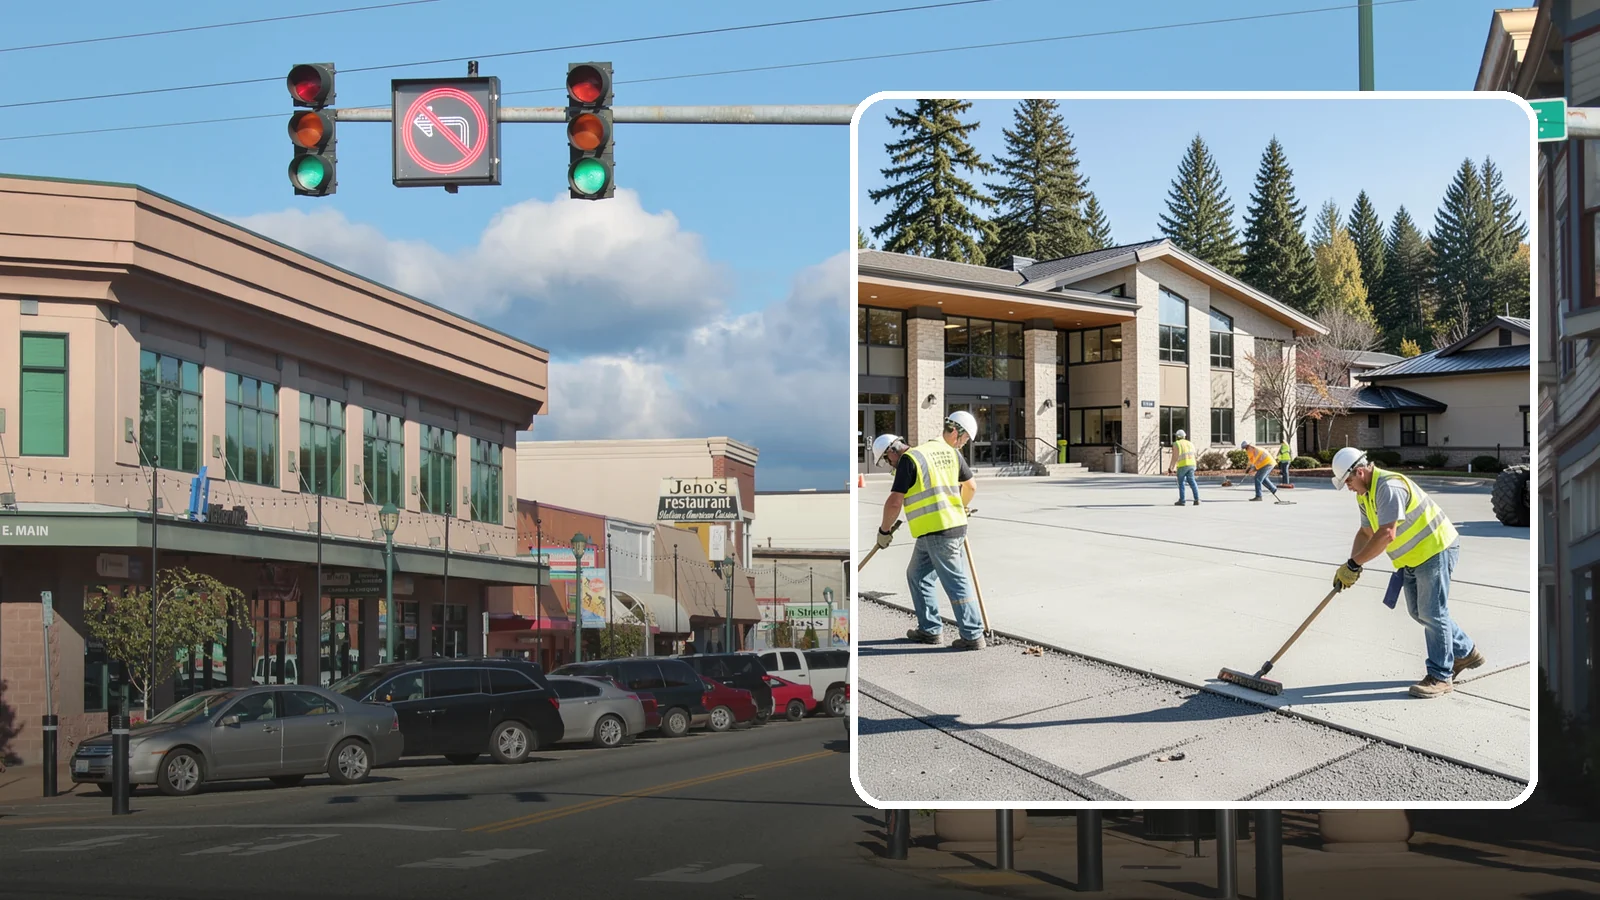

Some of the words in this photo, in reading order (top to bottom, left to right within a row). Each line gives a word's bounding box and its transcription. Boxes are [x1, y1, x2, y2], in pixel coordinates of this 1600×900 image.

[670, 480, 727, 494] Jeno's
[665, 496, 731, 508] restaurant
[686, 509, 714, 519] American
[715, 509, 737, 519] Cuisine
[2, 525, 13, 536] E.
[15, 525, 49, 536] MAIN
[797, 608, 829, 617] Street
[791, 619, 823, 627] lass
